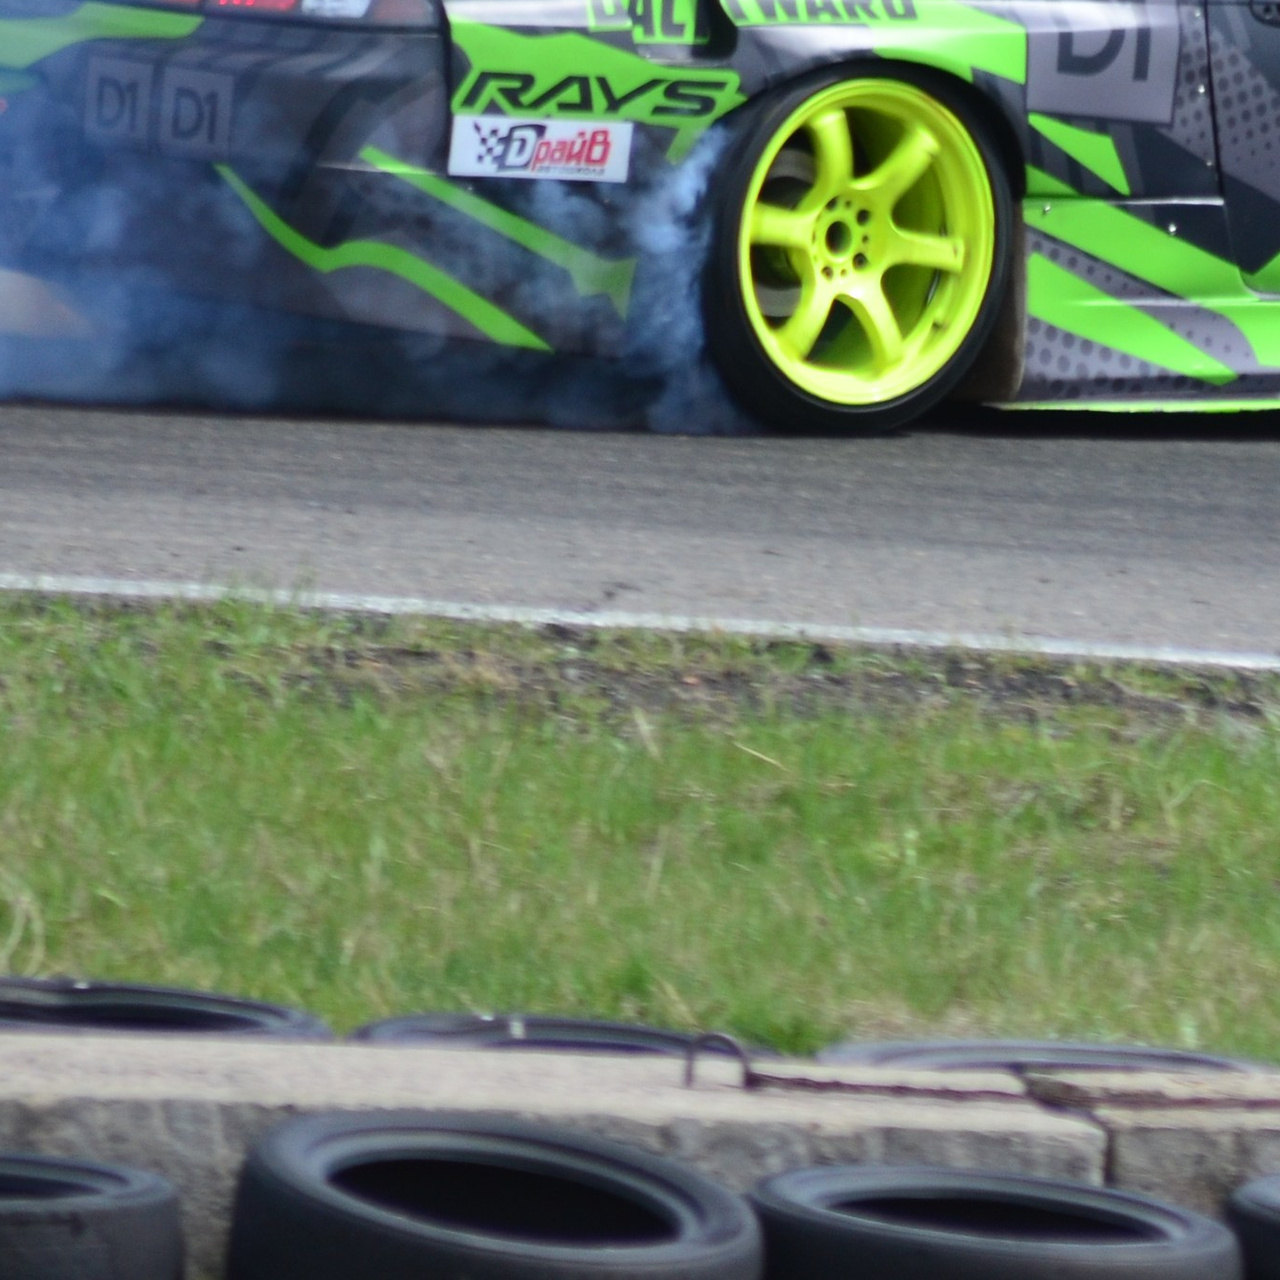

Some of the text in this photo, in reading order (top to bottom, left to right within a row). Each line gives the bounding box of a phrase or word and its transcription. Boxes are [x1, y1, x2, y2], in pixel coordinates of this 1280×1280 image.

[97, 77, 139, 131] D1
[171, 86, 219, 144] D1
[460, 71, 727, 116] RAYS
